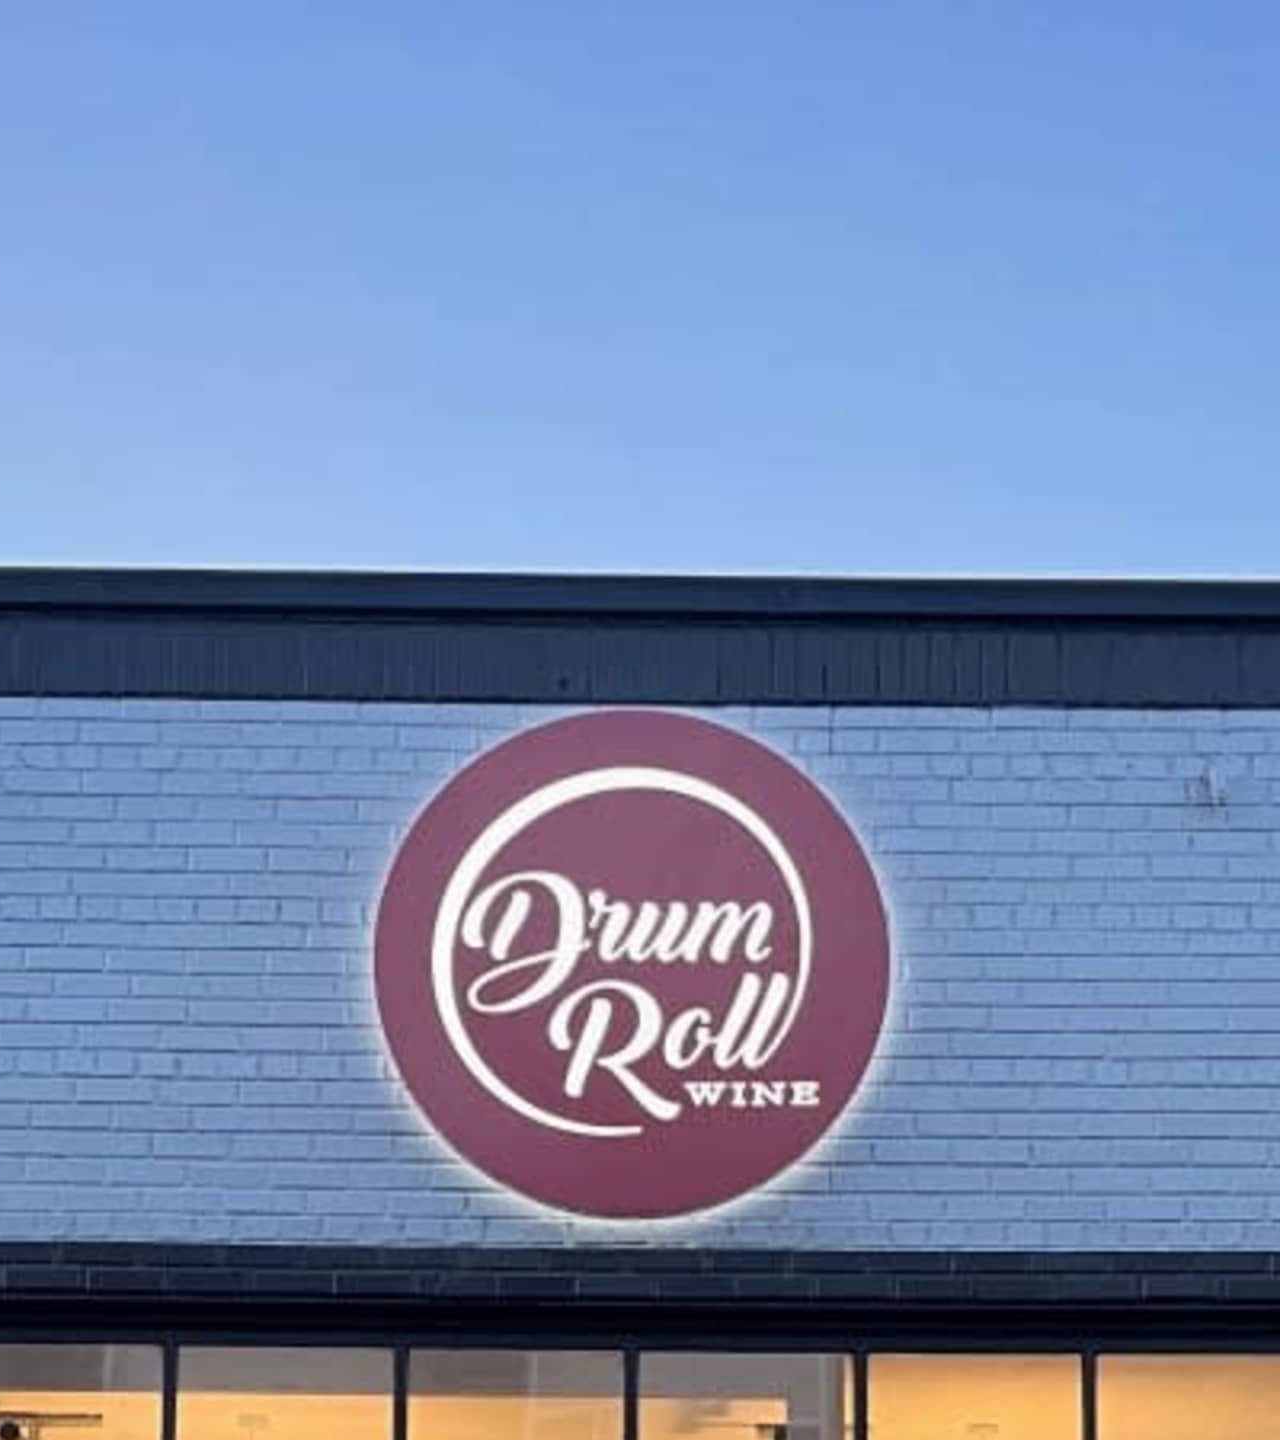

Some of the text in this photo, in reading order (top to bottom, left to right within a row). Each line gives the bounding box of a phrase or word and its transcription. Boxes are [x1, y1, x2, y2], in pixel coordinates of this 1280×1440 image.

[461, 870, 774, 1015] Drum
[548, 971, 790, 1121] Roll
[684, 1080, 821, 1107] WINE
